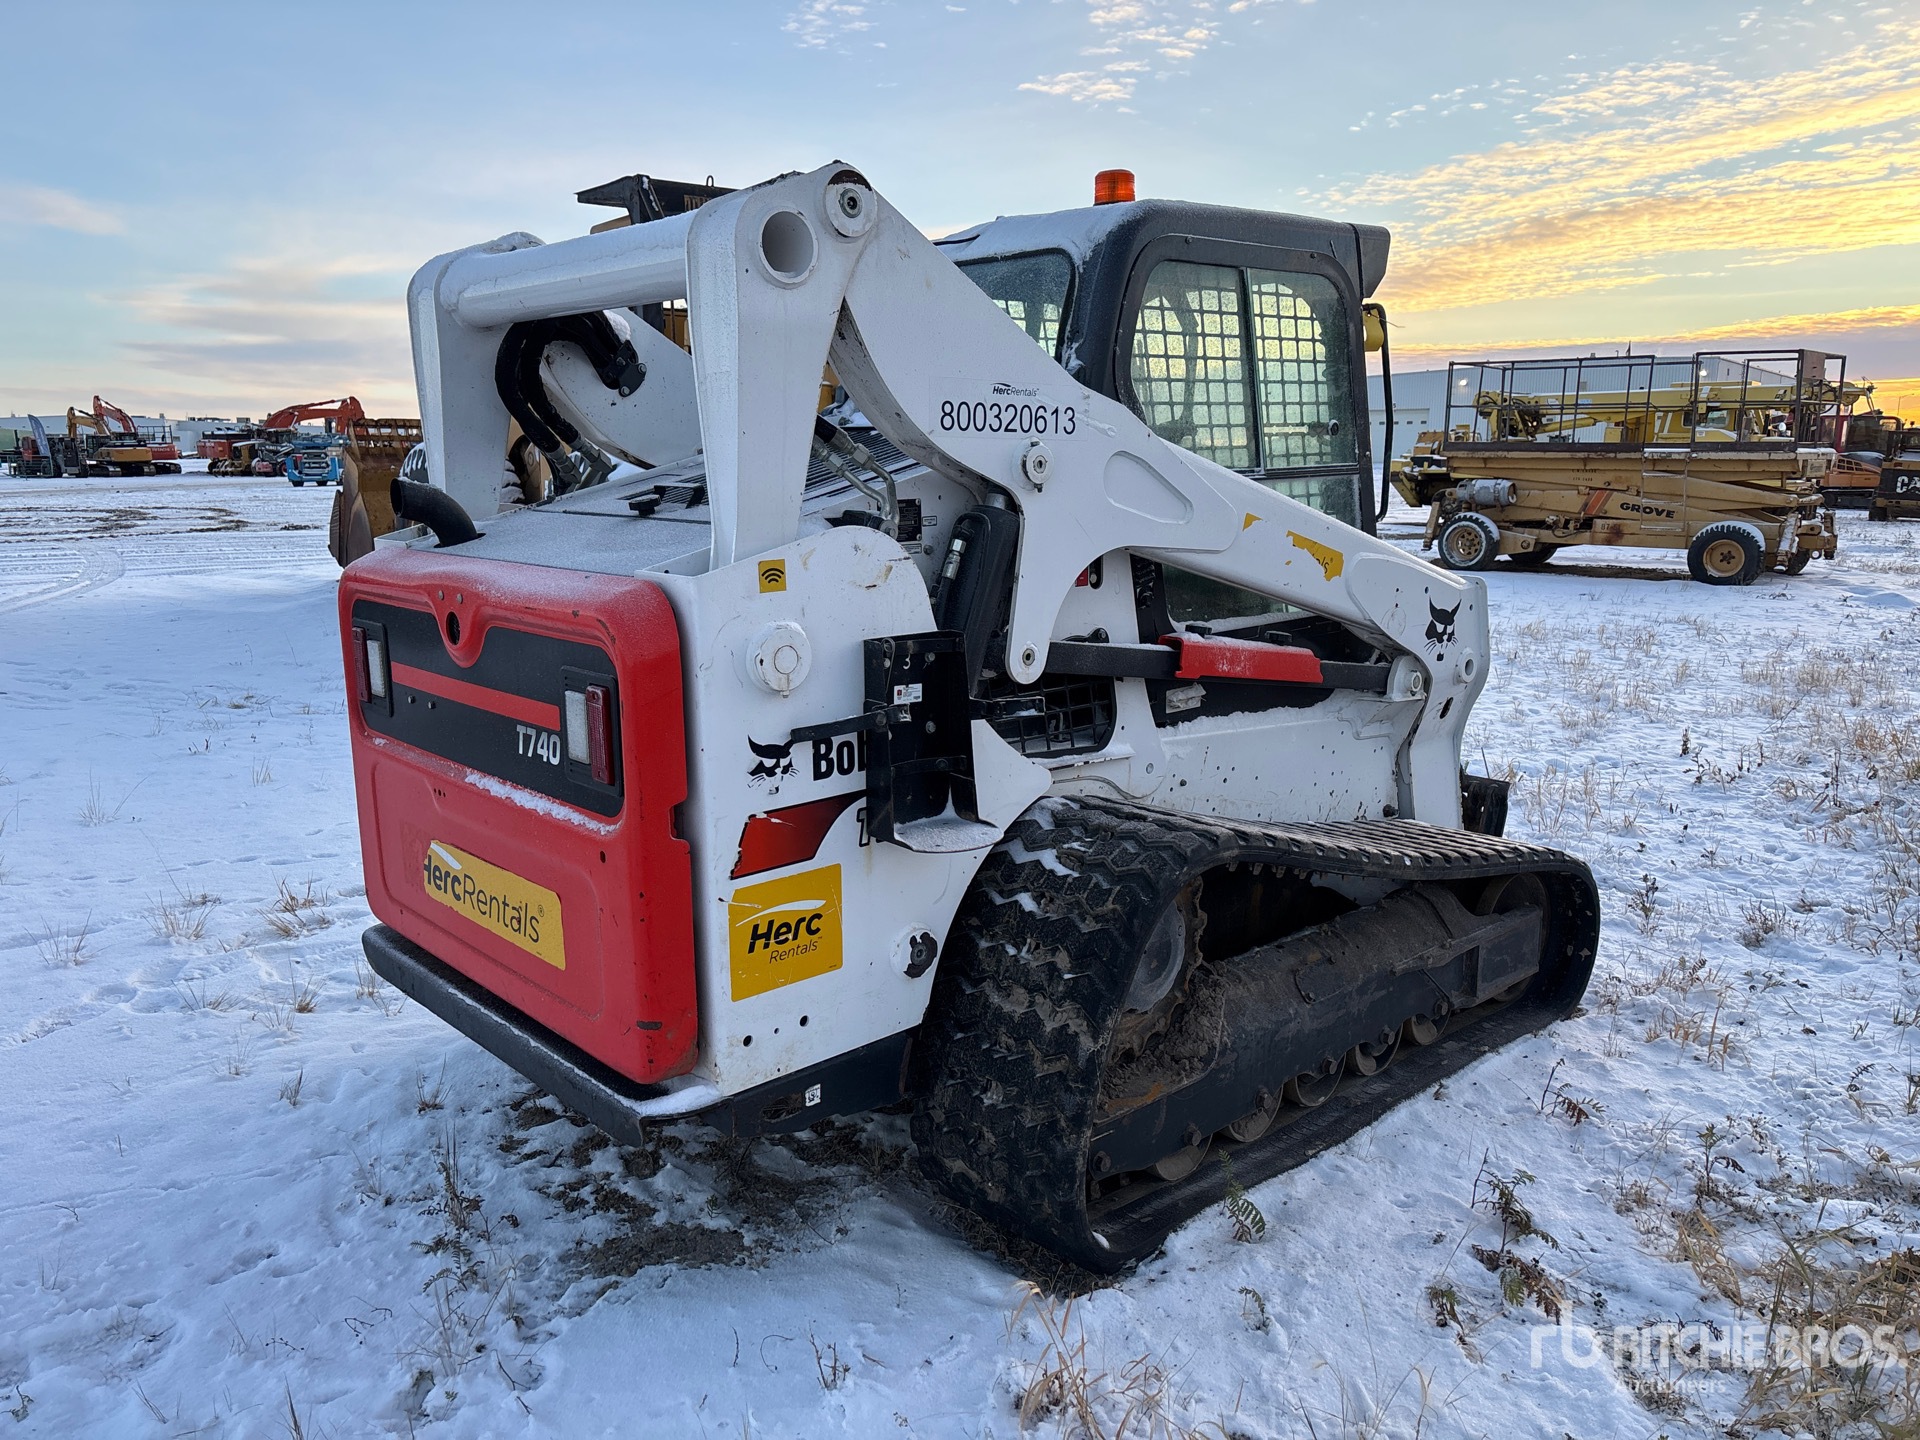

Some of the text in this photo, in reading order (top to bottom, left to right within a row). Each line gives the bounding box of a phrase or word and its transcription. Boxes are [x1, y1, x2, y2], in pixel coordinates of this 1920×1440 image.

[940, 400, 1076, 435] 800320613
[1620, 502, 1676, 519] GROVE
[516, 724, 561, 766] T740
[747, 912, 824, 955] Herc
[769, 939, 818, 964] Rentals
